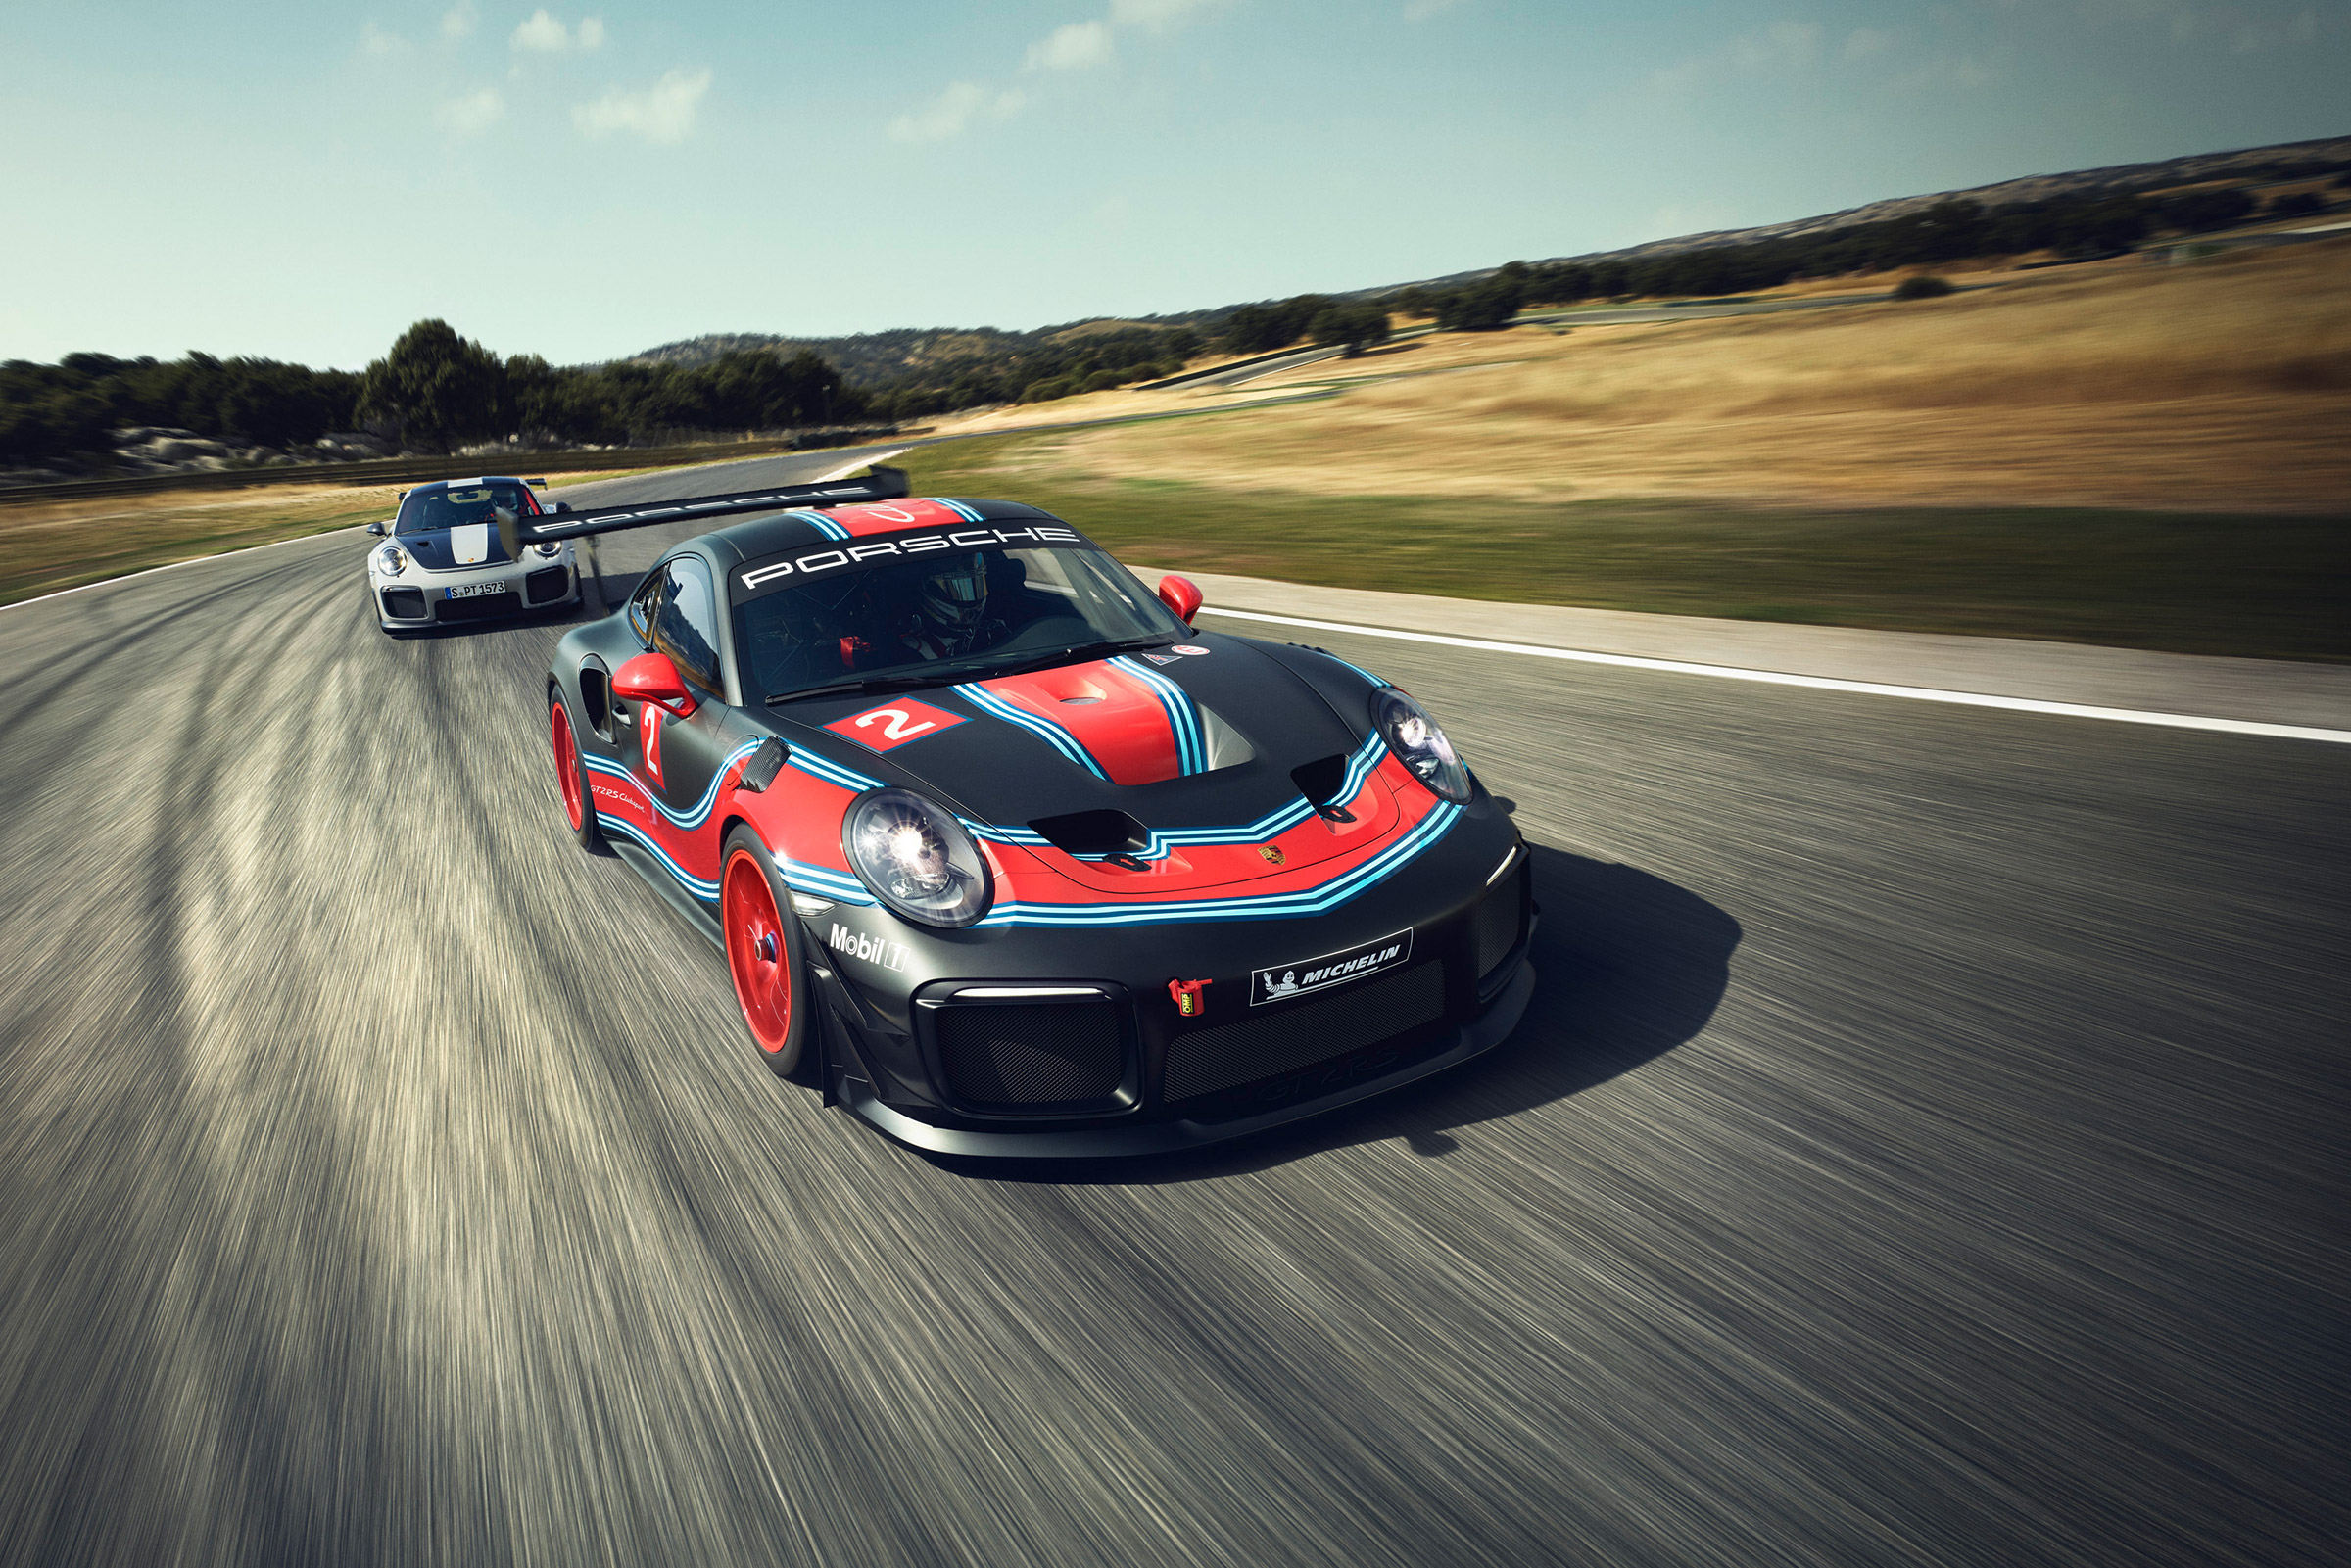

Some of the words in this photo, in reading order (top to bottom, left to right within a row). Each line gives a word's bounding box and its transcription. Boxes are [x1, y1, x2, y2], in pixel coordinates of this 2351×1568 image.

[740, 526, 1080, 589] PORSCHE
[451, 588, 458, 597] S
[463, 585, 477, 595] PT
[479, 581, 504, 594] 1573
[644, 706, 659, 776] 2
[855, 709, 936, 740] 2
[830, 923, 885, 965] Mobil
[1301, 944, 1401, 985] MICHELIN
